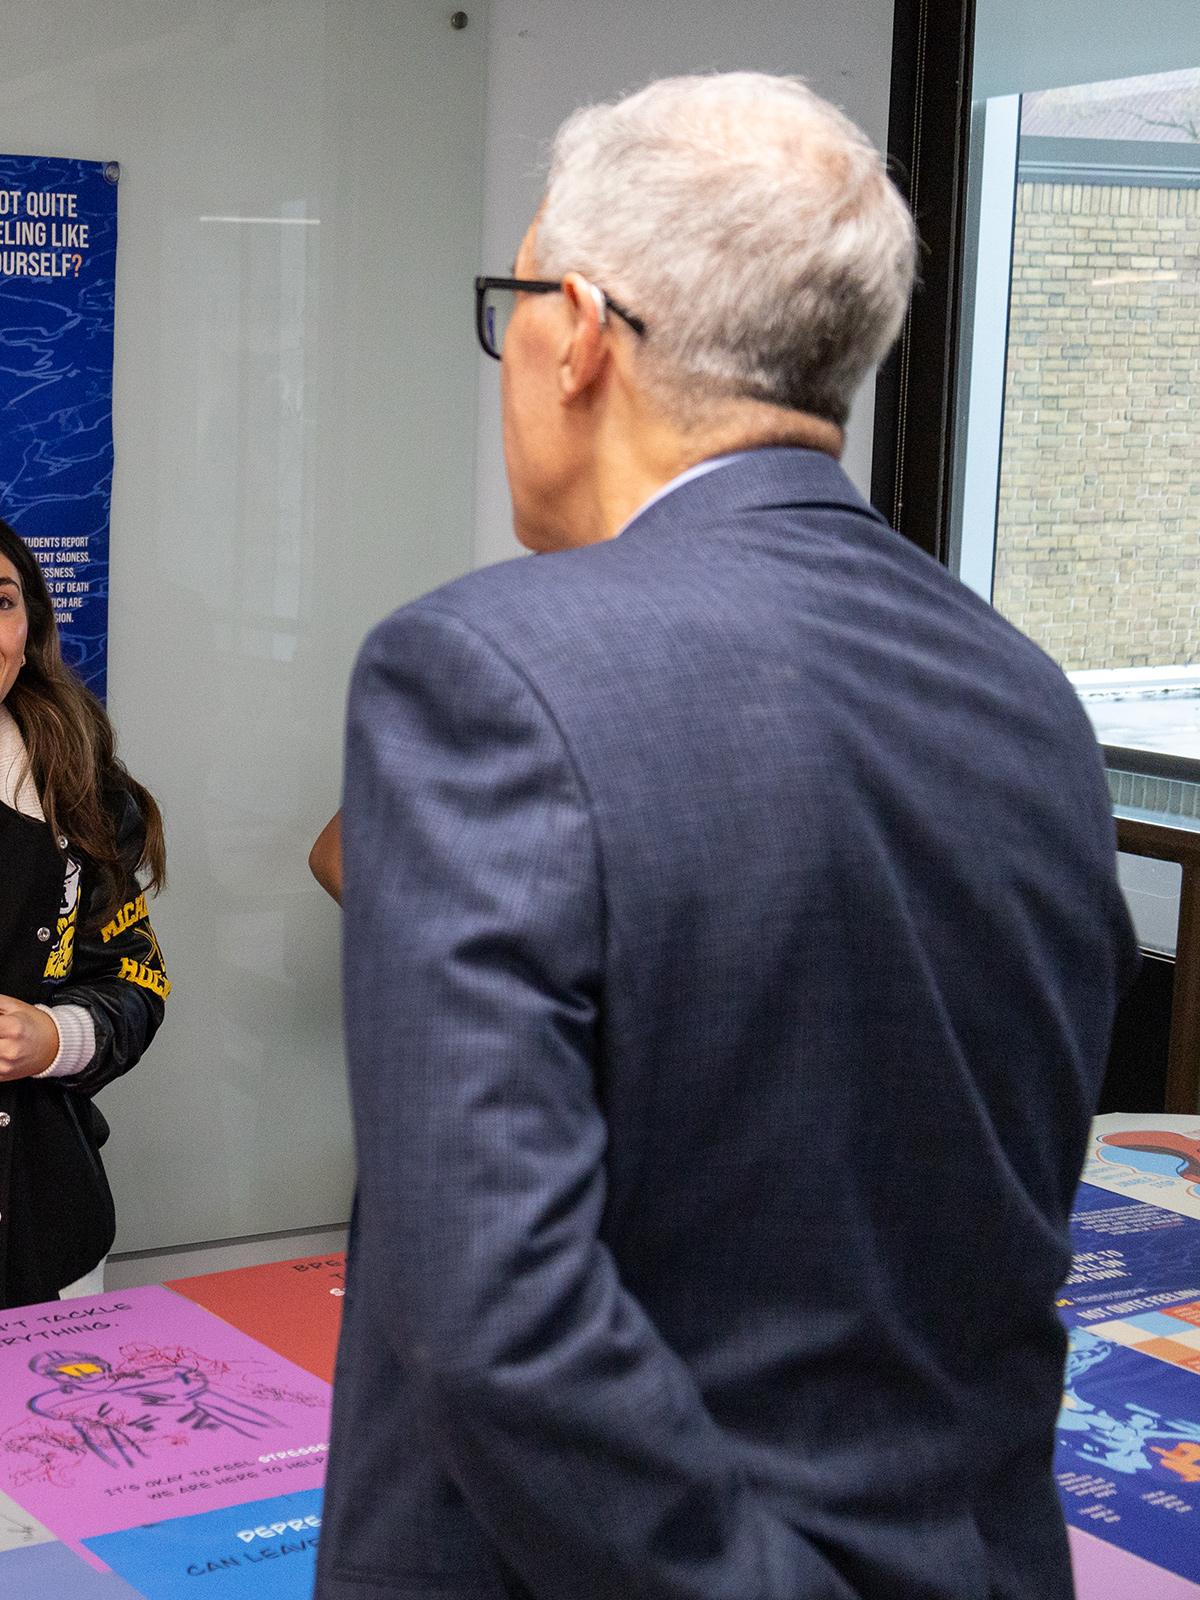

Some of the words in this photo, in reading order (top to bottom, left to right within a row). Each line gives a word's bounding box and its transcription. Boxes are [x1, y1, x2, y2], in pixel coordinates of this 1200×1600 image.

[26, 191, 78, 218] QUITE
[51, 223, 90, 248] LIKE
[21, 537, 60, 548] TUDENTS
[61, 536, 89, 547] REPORT
[56, 552, 91, 563] SADNESS,
[55, 582, 65, 593] OF
[67, 582, 89, 593] DEATH
[68, 597, 83, 608] ARE
[38, 1303, 133, 1325] TACKLE
[1076, 1307, 1112, 1320] NOT
[104, 1483, 140, 1497] IT'S
[145, 1473, 184, 1489] OKAY
[189, 1467, 210, 1478] TO
[213, 1459, 256, 1474] FEEL
[258, 1442, 330, 1464] STRESSE
[147, 1490, 175, 1500] WE
[179, 1481, 213, 1494] ARE
[215, 1471, 259, 1487] HERE
[262, 1466, 282, 1475] TO
[285, 1456, 326, 1471] HELP
[186, 1556, 242, 1577] CAN
